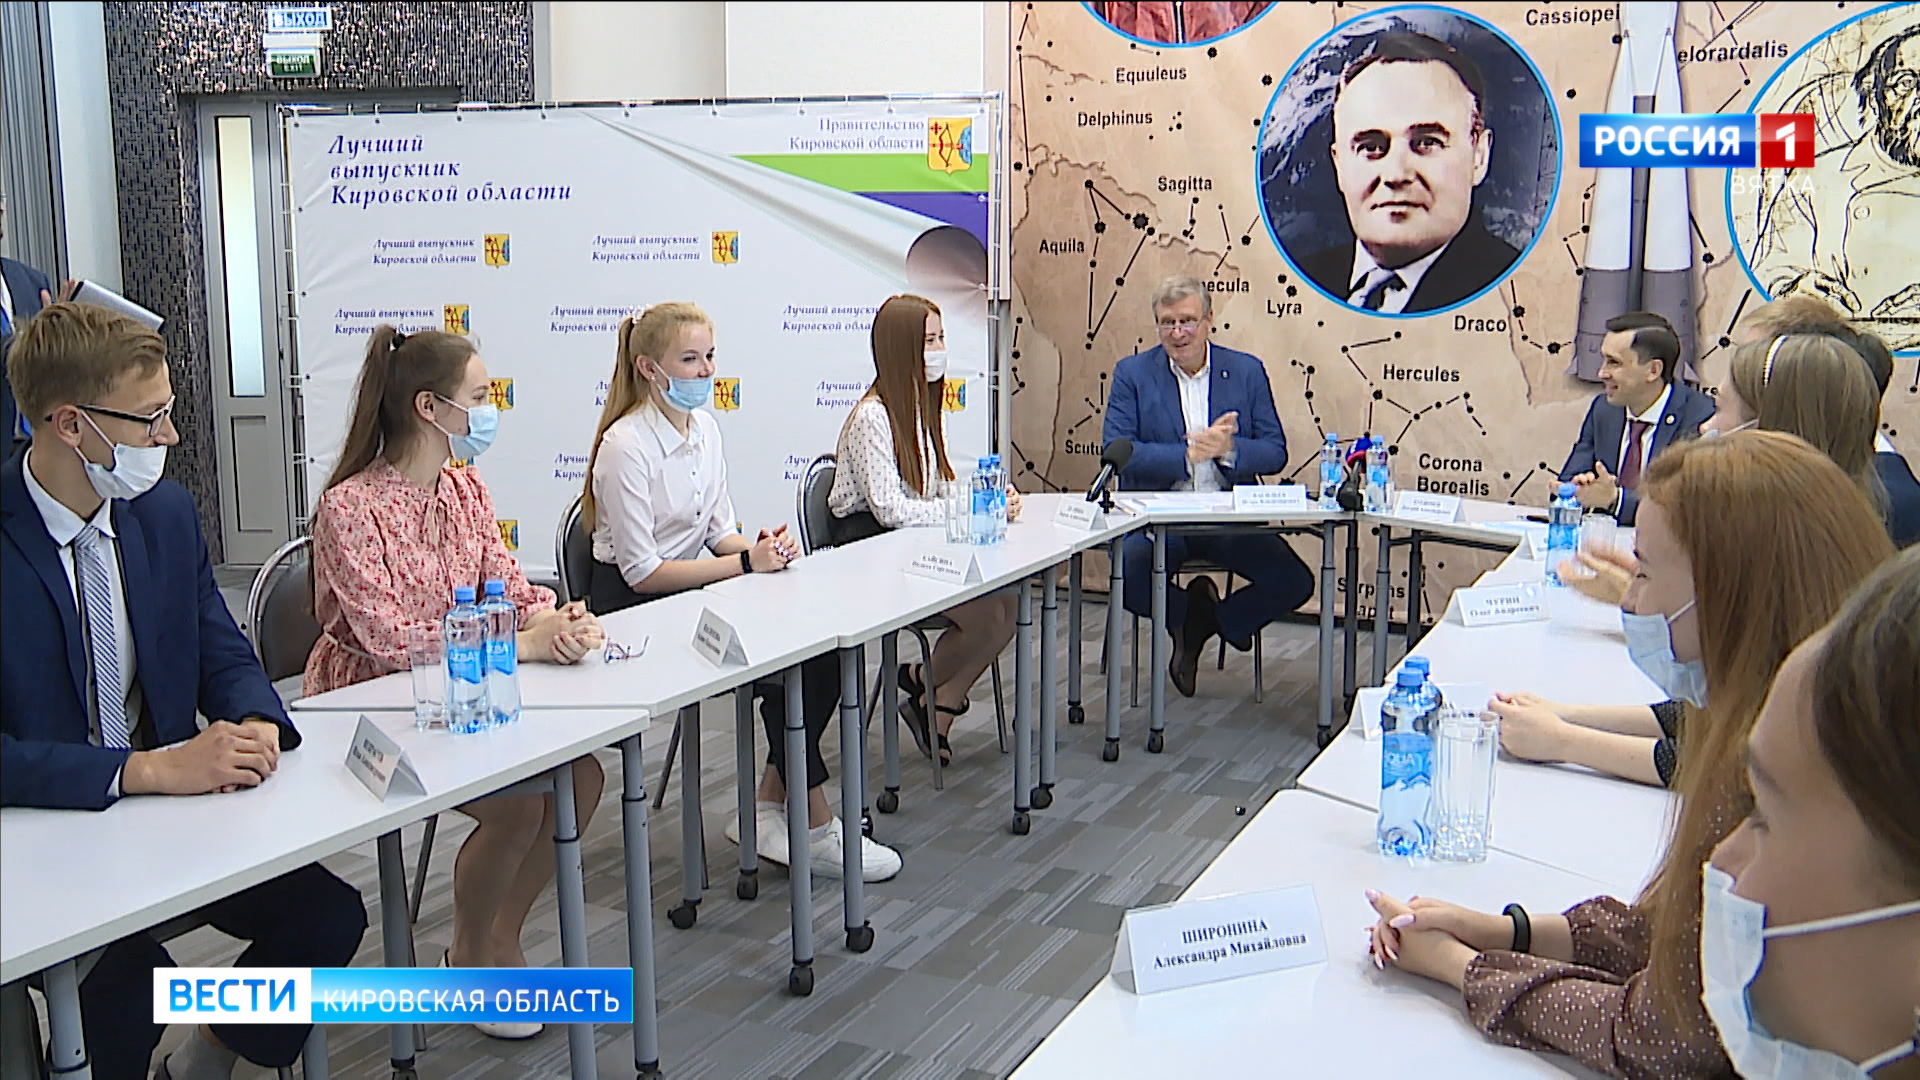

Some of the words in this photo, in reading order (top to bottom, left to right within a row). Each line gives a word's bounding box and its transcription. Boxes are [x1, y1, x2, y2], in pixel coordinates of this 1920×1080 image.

[274, 12, 326, 27] ВЫХОД
[1677, 40, 1788, 63] elorardalis
[1116, 66, 1187, 85] Equuleus
[819, 118, 925, 133] Правительство
[1078, 111, 1153, 128] Delphinus
[328, 134, 424, 160] Лучший
[790, 136, 864, 150] Кировской
[869, 135, 924, 149] области
[330, 162, 460, 185] выпускник
[1157, 175, 1213, 194] Sagitta
[331, 184, 459, 209] Кировской
[466, 181, 572, 203] области
[373, 239, 415, 251] Лучший
[418, 239, 475, 250] выпускник
[593, 235, 636, 247] Лучший
[639, 236, 700, 247] выпускник
[1039, 238, 1085, 255] Aquila
[373, 253, 428, 267] Кировской
[431, 254, 477, 264] области
[592, 250, 649, 263] Кировской
[652, 250, 700, 260] области
[335, 307, 376, 320] Лучший
[378, 308, 435, 319] выпускник
[550, 305, 594, 318] Лучший
[783, 305, 828, 316] Лучший
[1267, 299, 1302, 318] Lyra
[550, 321, 607, 334] Кировской
[783, 321, 841, 333] Кировской
[1454, 315, 1507, 332] Draco
[1383, 363, 1460, 382] Hercules
[816, 381, 862, 393] Лучший
[1419, 453, 1482, 472] Corona
[1417, 475, 1489, 496] Borealis
[1182, 918, 1268, 944] ШИРОНИНА
[1154, 947, 1227, 970] Александра
[1230, 933, 1307, 956] Михайловна
